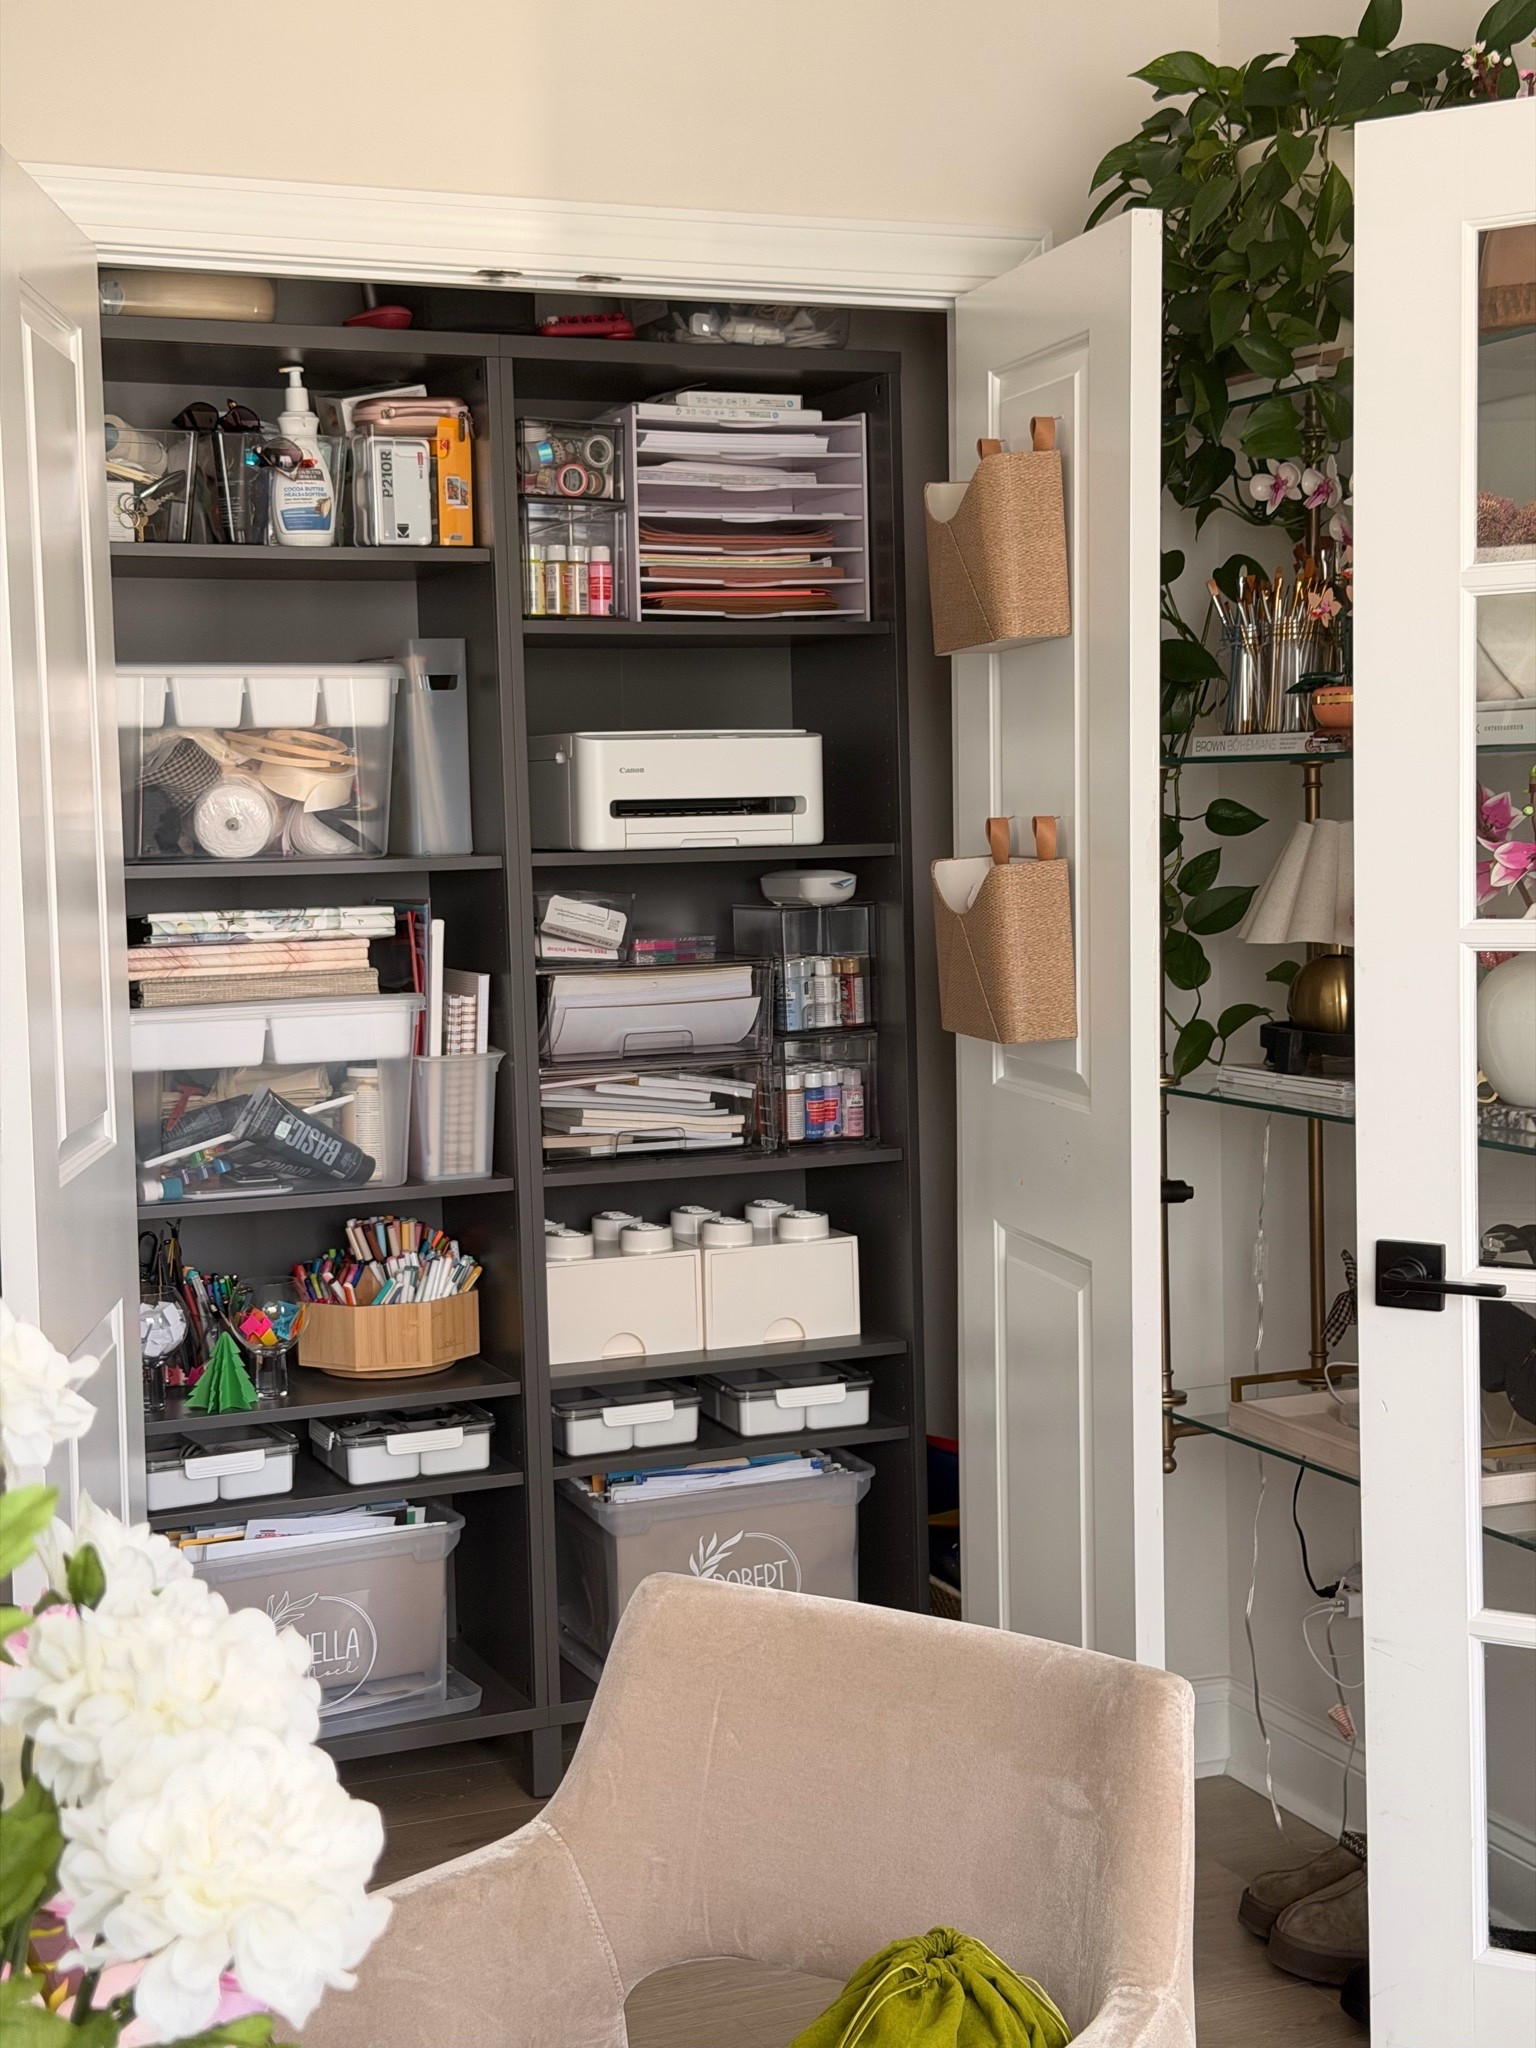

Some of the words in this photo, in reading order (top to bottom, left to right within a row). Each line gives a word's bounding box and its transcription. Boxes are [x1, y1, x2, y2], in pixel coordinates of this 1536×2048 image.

[381, 451, 393, 498] P210R
[1195, 740, 1226, 753] BROWN
[306, 1628, 360, 1664] ELLA
